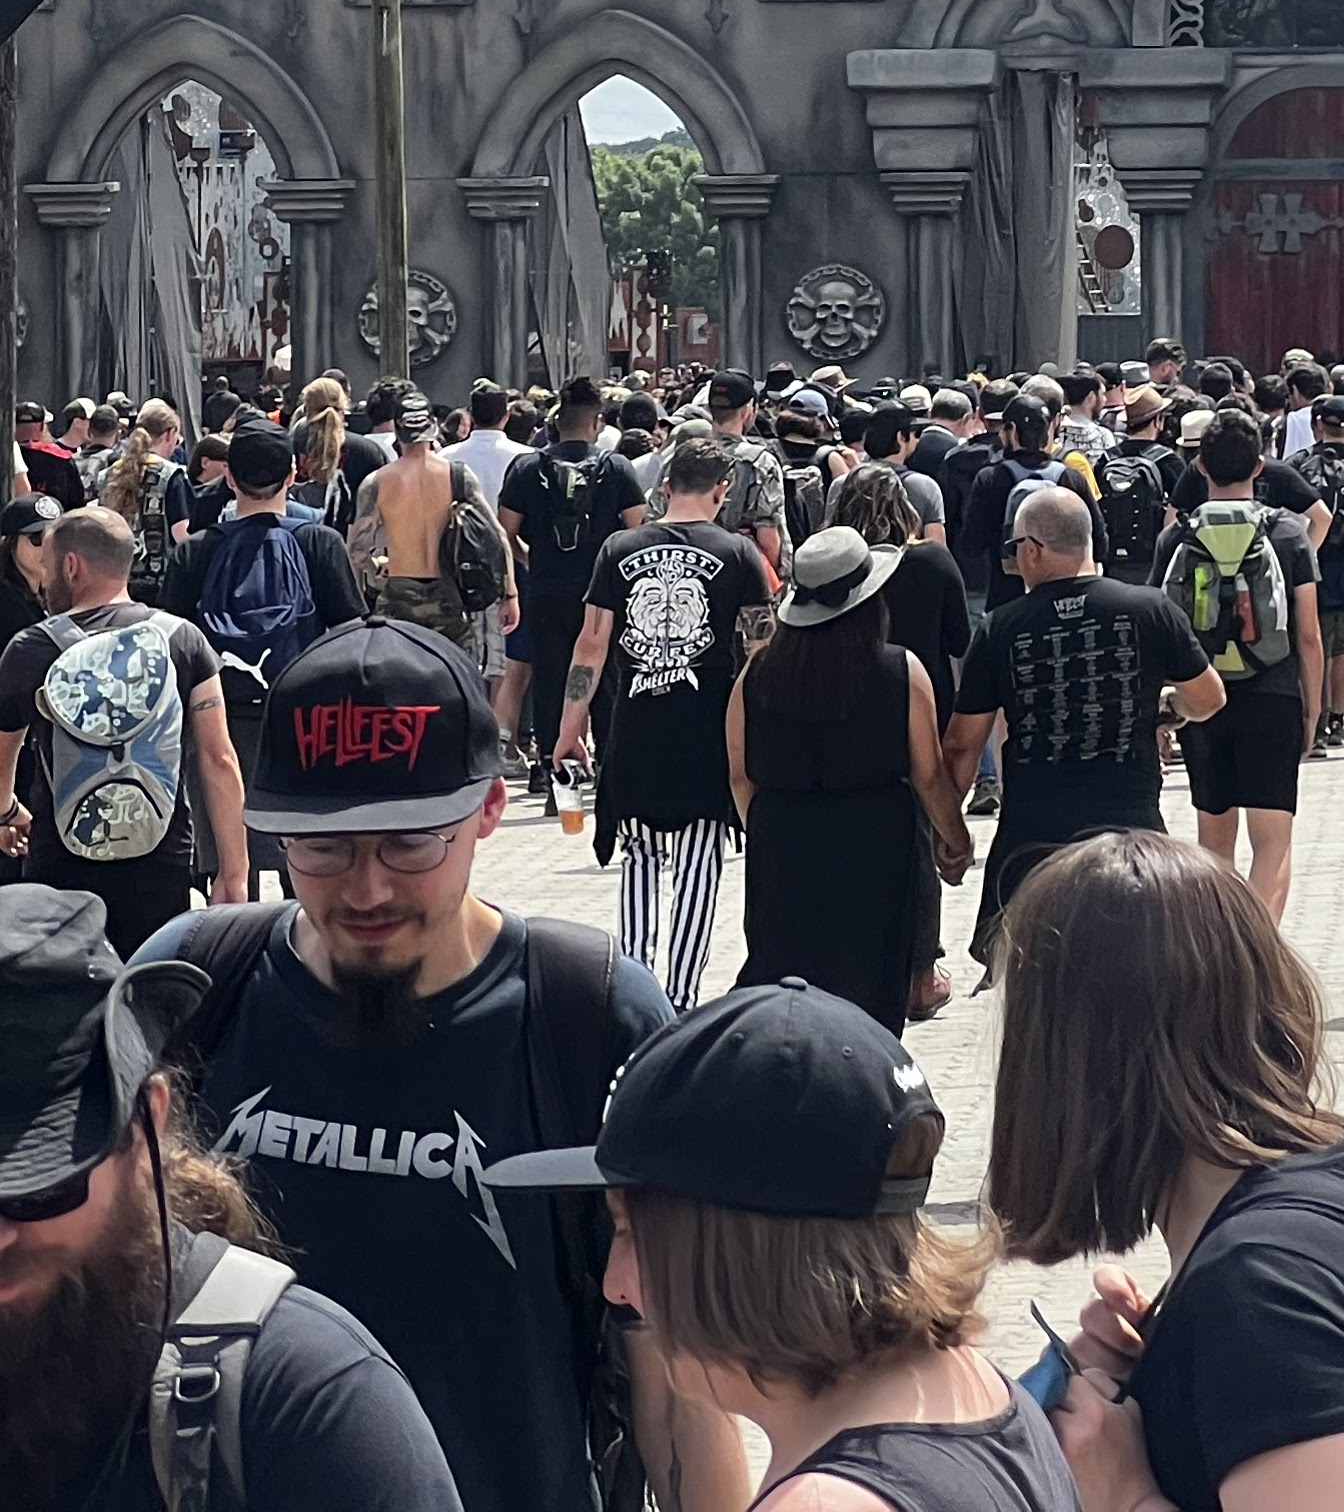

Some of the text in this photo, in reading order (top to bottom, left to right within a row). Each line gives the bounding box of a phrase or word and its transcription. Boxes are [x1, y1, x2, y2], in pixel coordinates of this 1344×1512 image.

[628, 550, 712, 570] THIRST
[624, 633, 711, 657] CURFEW
[637, 667, 686, 692] SHELTER
[293, 694, 441, 772] HELLFEST
[213, 1085, 517, 1270] METALLICA
